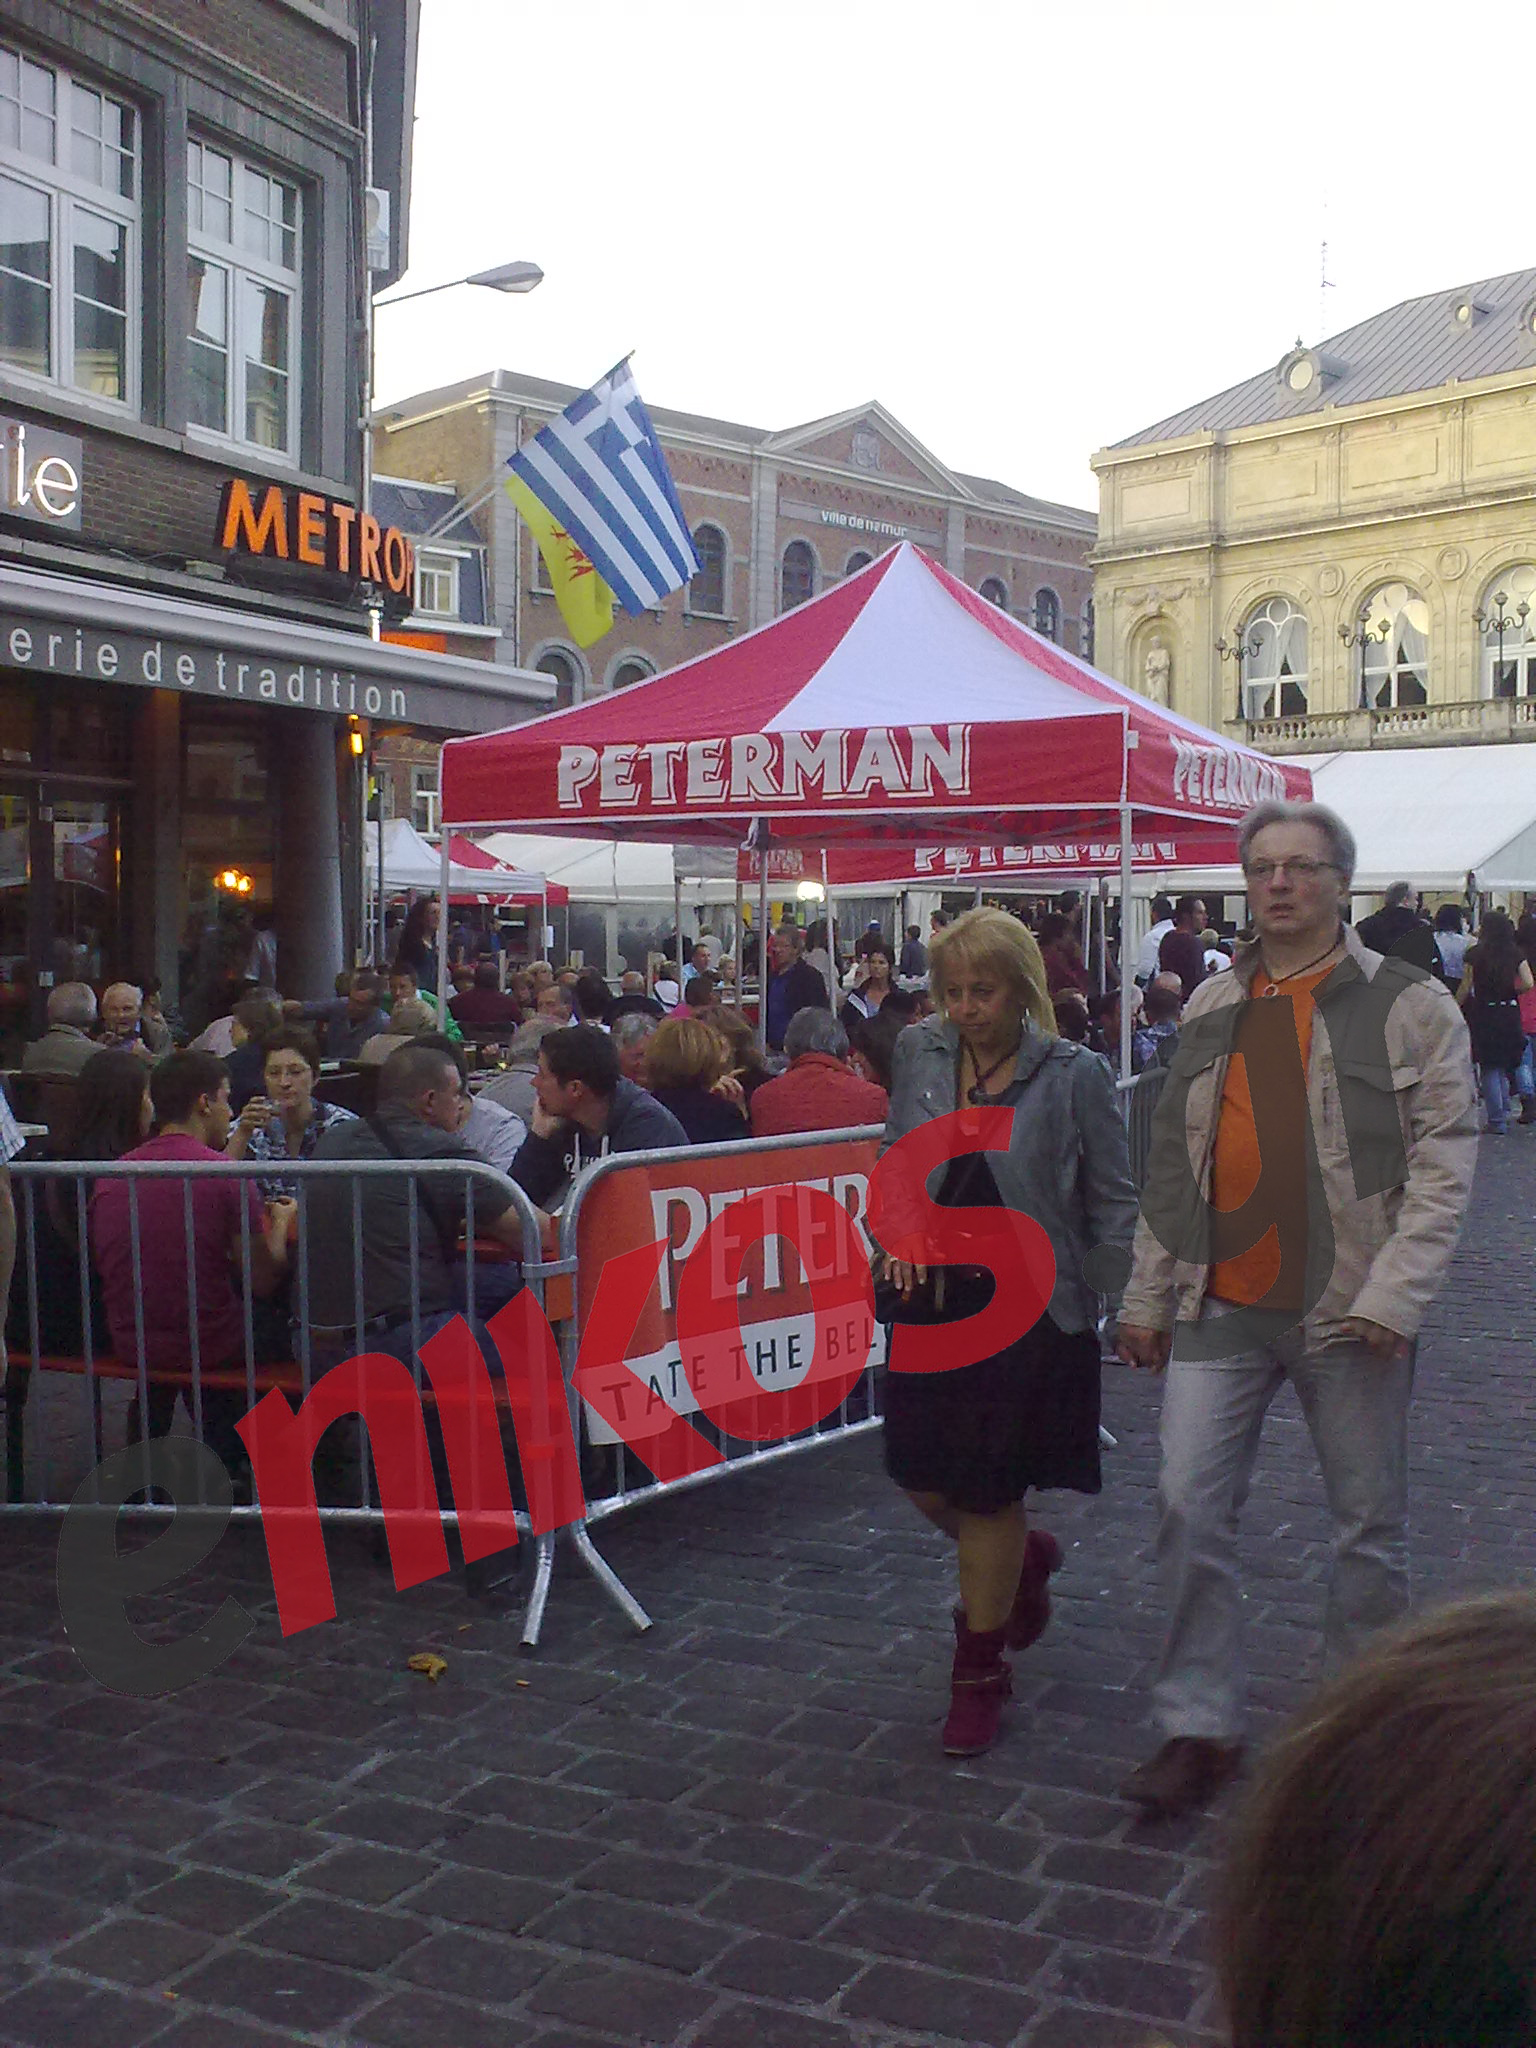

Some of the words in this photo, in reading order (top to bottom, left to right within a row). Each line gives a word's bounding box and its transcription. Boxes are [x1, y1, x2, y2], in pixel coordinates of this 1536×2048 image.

[0, 425, 79, 517] ie
[220, 477, 414, 598] METROP
[848, 515, 864, 530] de
[865, 518, 908, 537] namur
[9, 627, 119, 676] erie
[142, 641, 196, 686] de
[216, 653, 406, 717] tradition
[557, 723, 972, 809] PETERMAN
[1168, 732, 1287, 811] PETERMAN
[728, 1333, 803, 1382] THE
[825, 1316, 878, 1361] BEL
